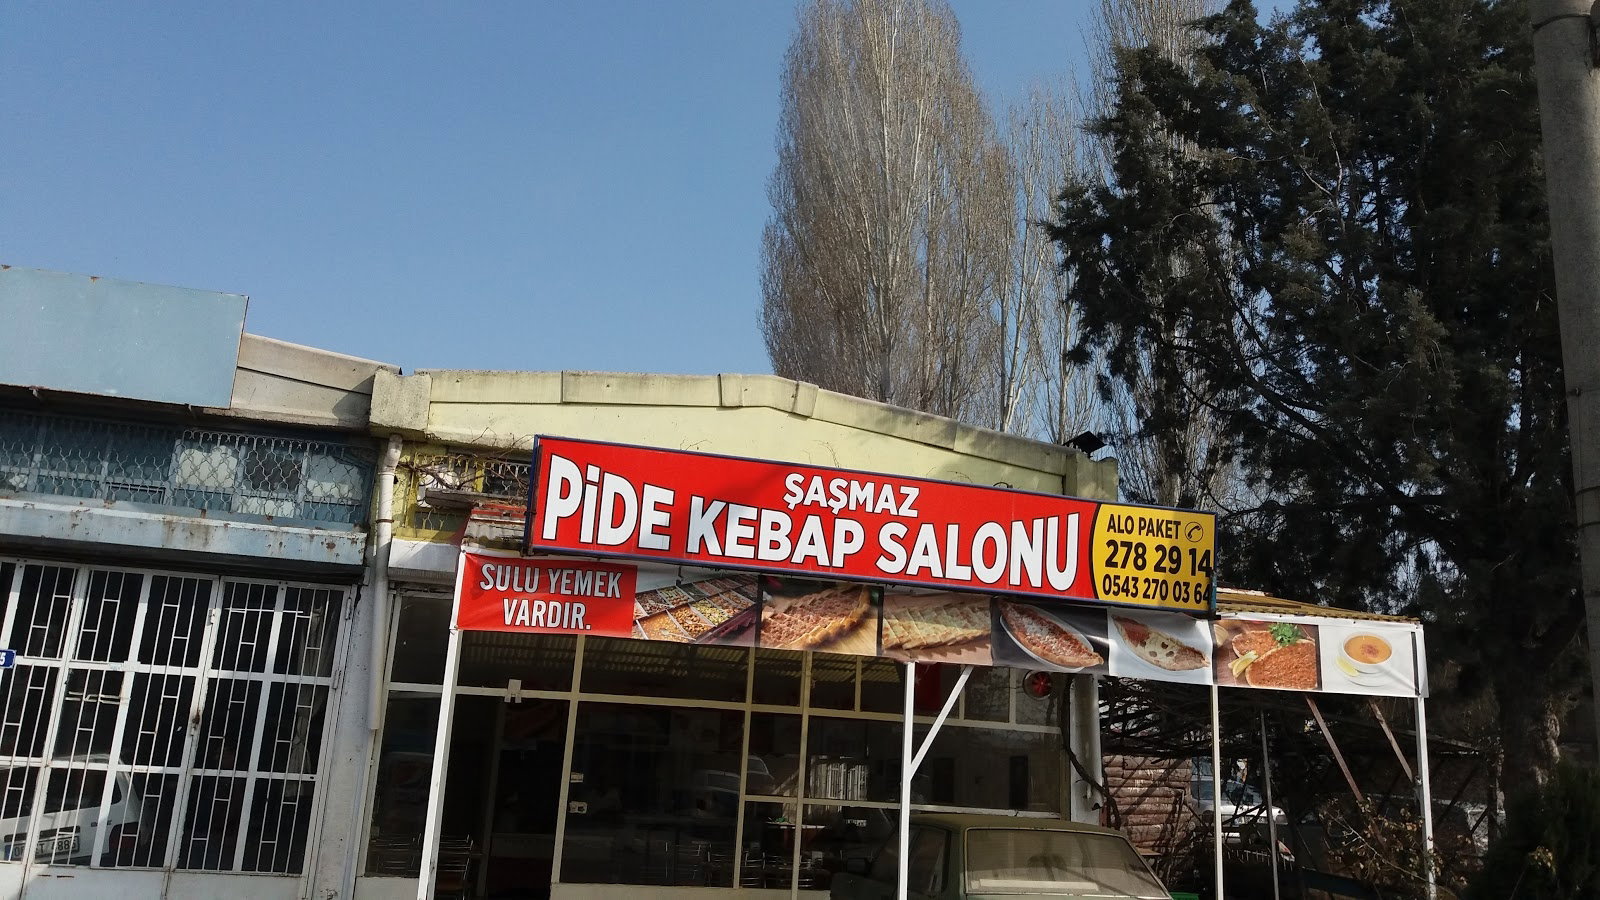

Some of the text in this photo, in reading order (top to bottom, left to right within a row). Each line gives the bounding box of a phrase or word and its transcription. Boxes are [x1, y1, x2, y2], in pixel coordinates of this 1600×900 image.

[783, 472, 920, 518] ŞAŞMAZ
[686, 494, 866, 568] KEBAP
[875, 512, 1080, 592] SALONU
[1106, 513, 1182, 540] ALO PAKET
[1104, 539, 1212, 578] 278 29 14
[479, 563, 623, 599] SULU YEMEK
[1102, 573, 1211, 605] 0543 270 03 64
[503, 597, 592, 631] VARDIR.
